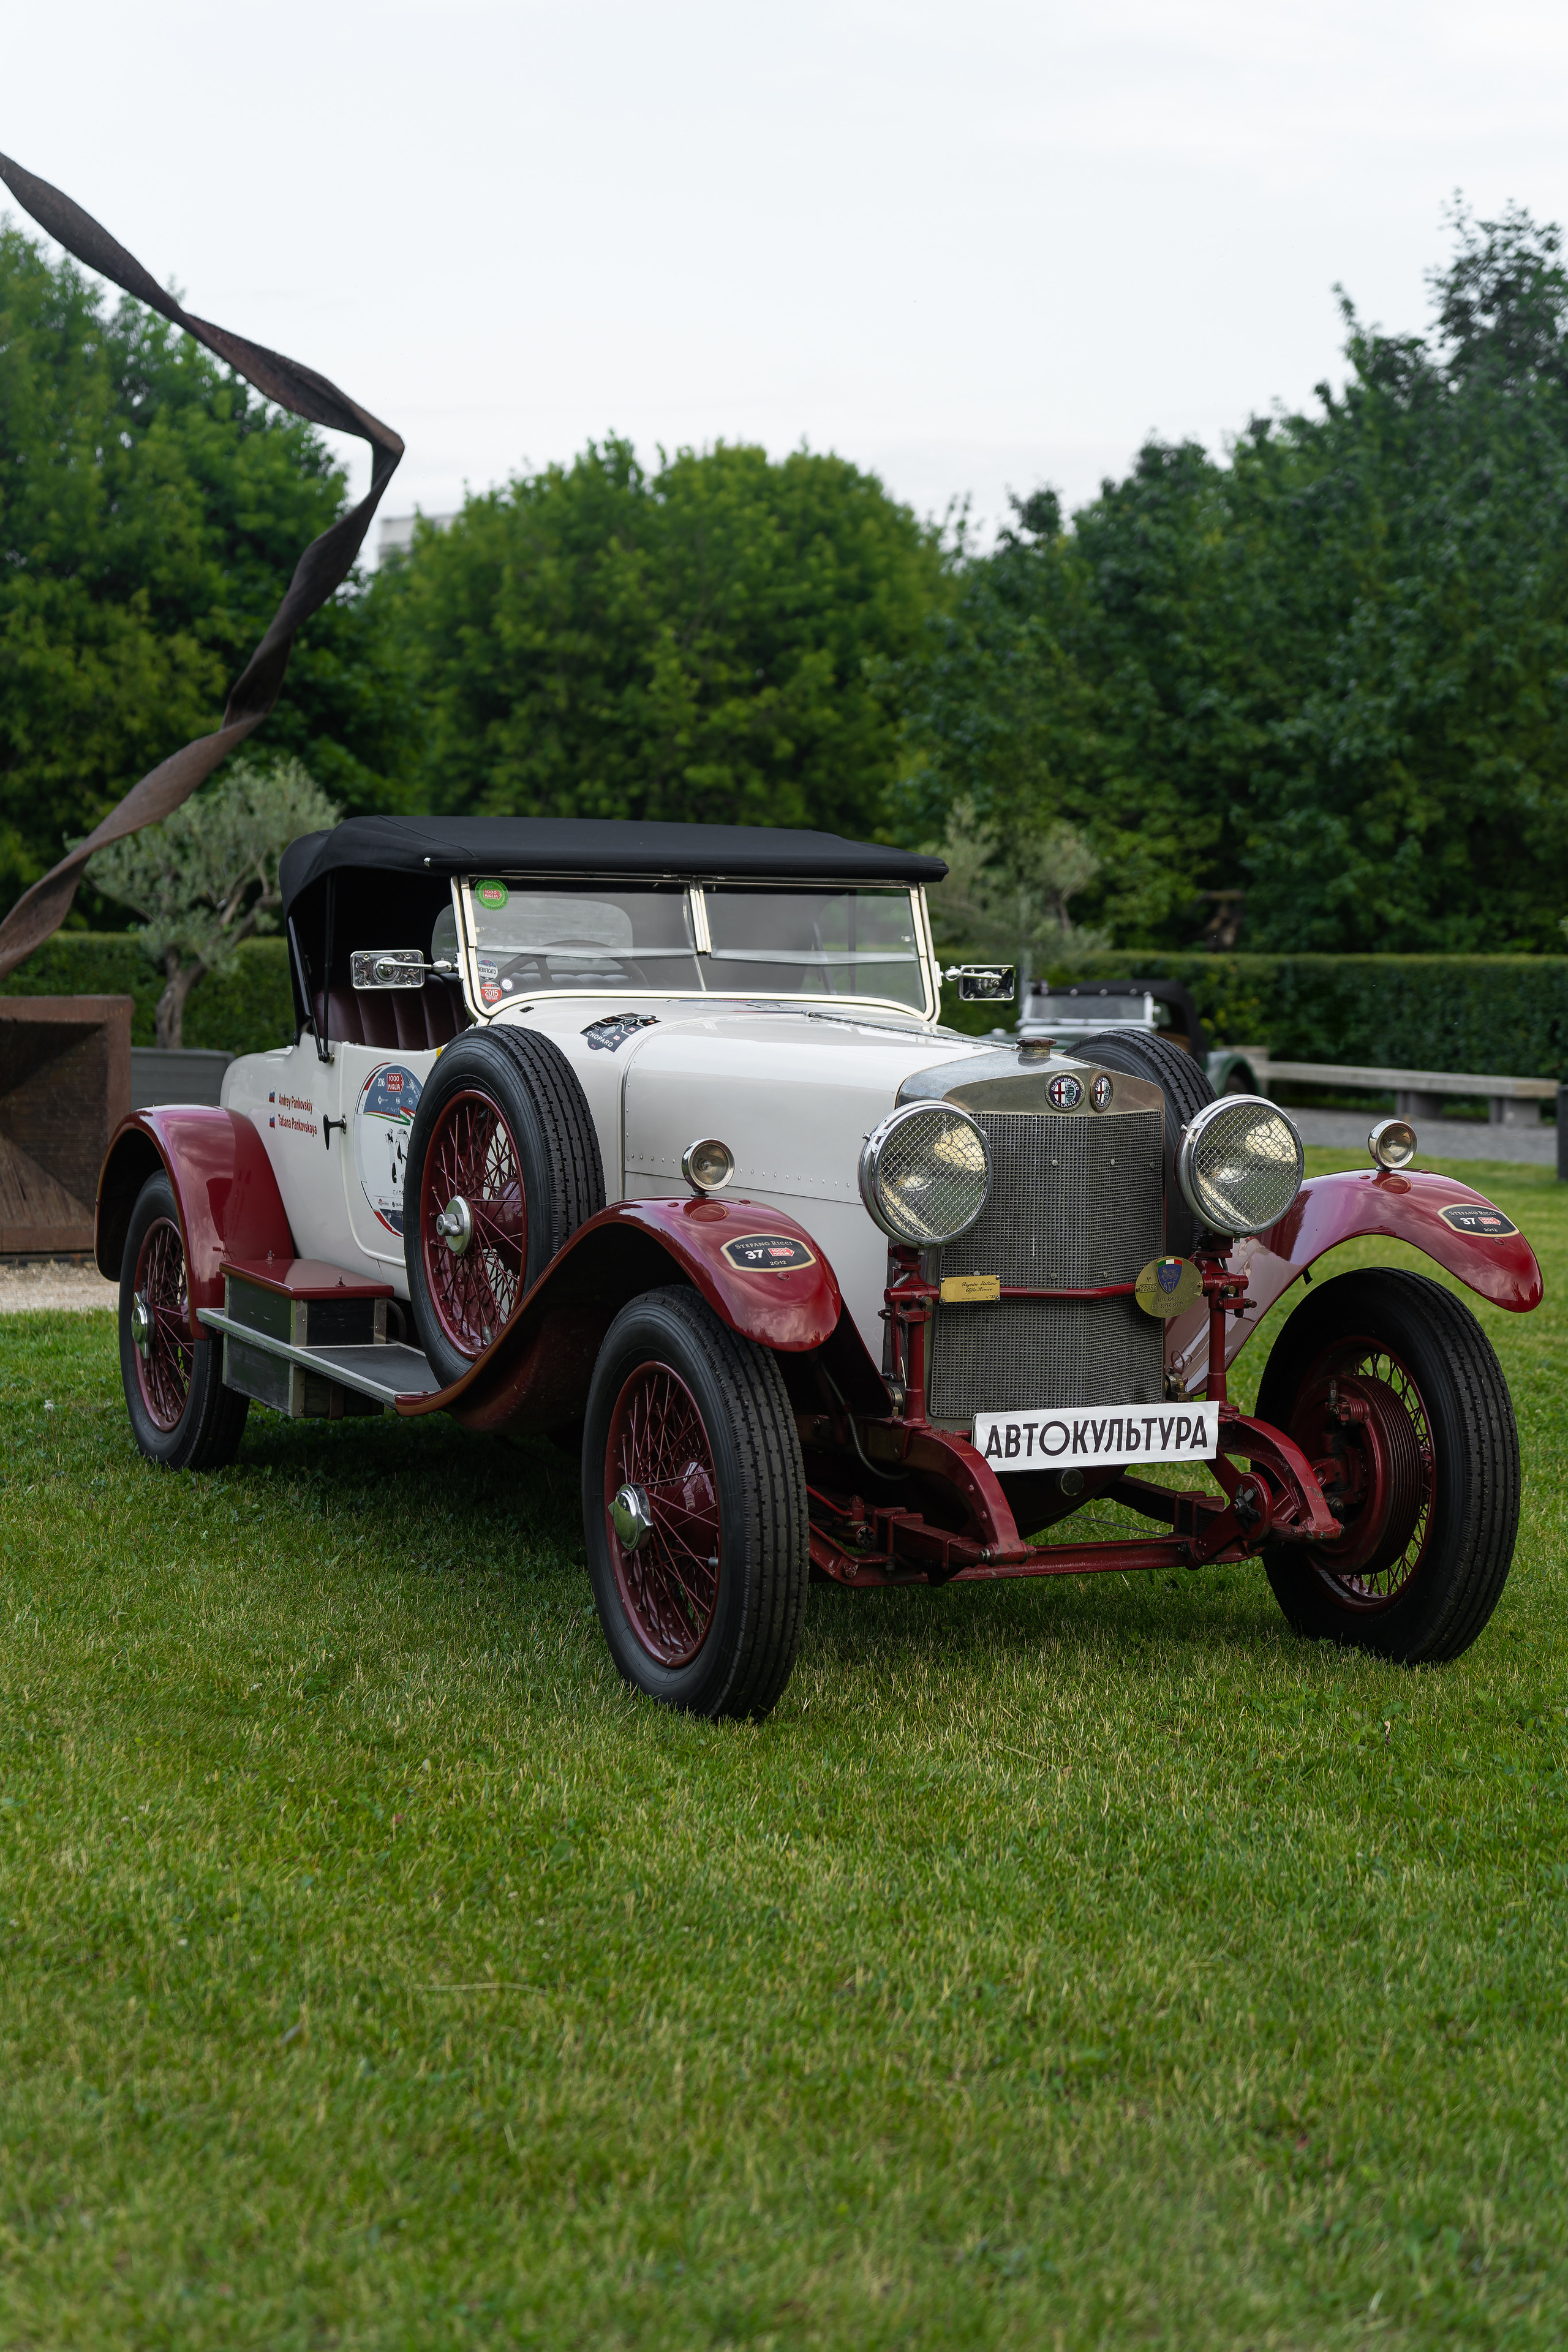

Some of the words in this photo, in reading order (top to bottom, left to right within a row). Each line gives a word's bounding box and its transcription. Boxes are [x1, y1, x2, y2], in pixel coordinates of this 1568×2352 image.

[587, 1031, 614, 1047] CHOPARD
[279, 1093, 291, 1110] Andrey
[292, 1095, 312, 1115] Pankovskiy
[278, 1114, 291, 1129] Tatiana
[292, 1117, 317, 1137] Pankovskaya
[745, 1250, 763, 1259] 37
[985, 1415, 1208, 1459] АВТОКУЛЬТУРА
